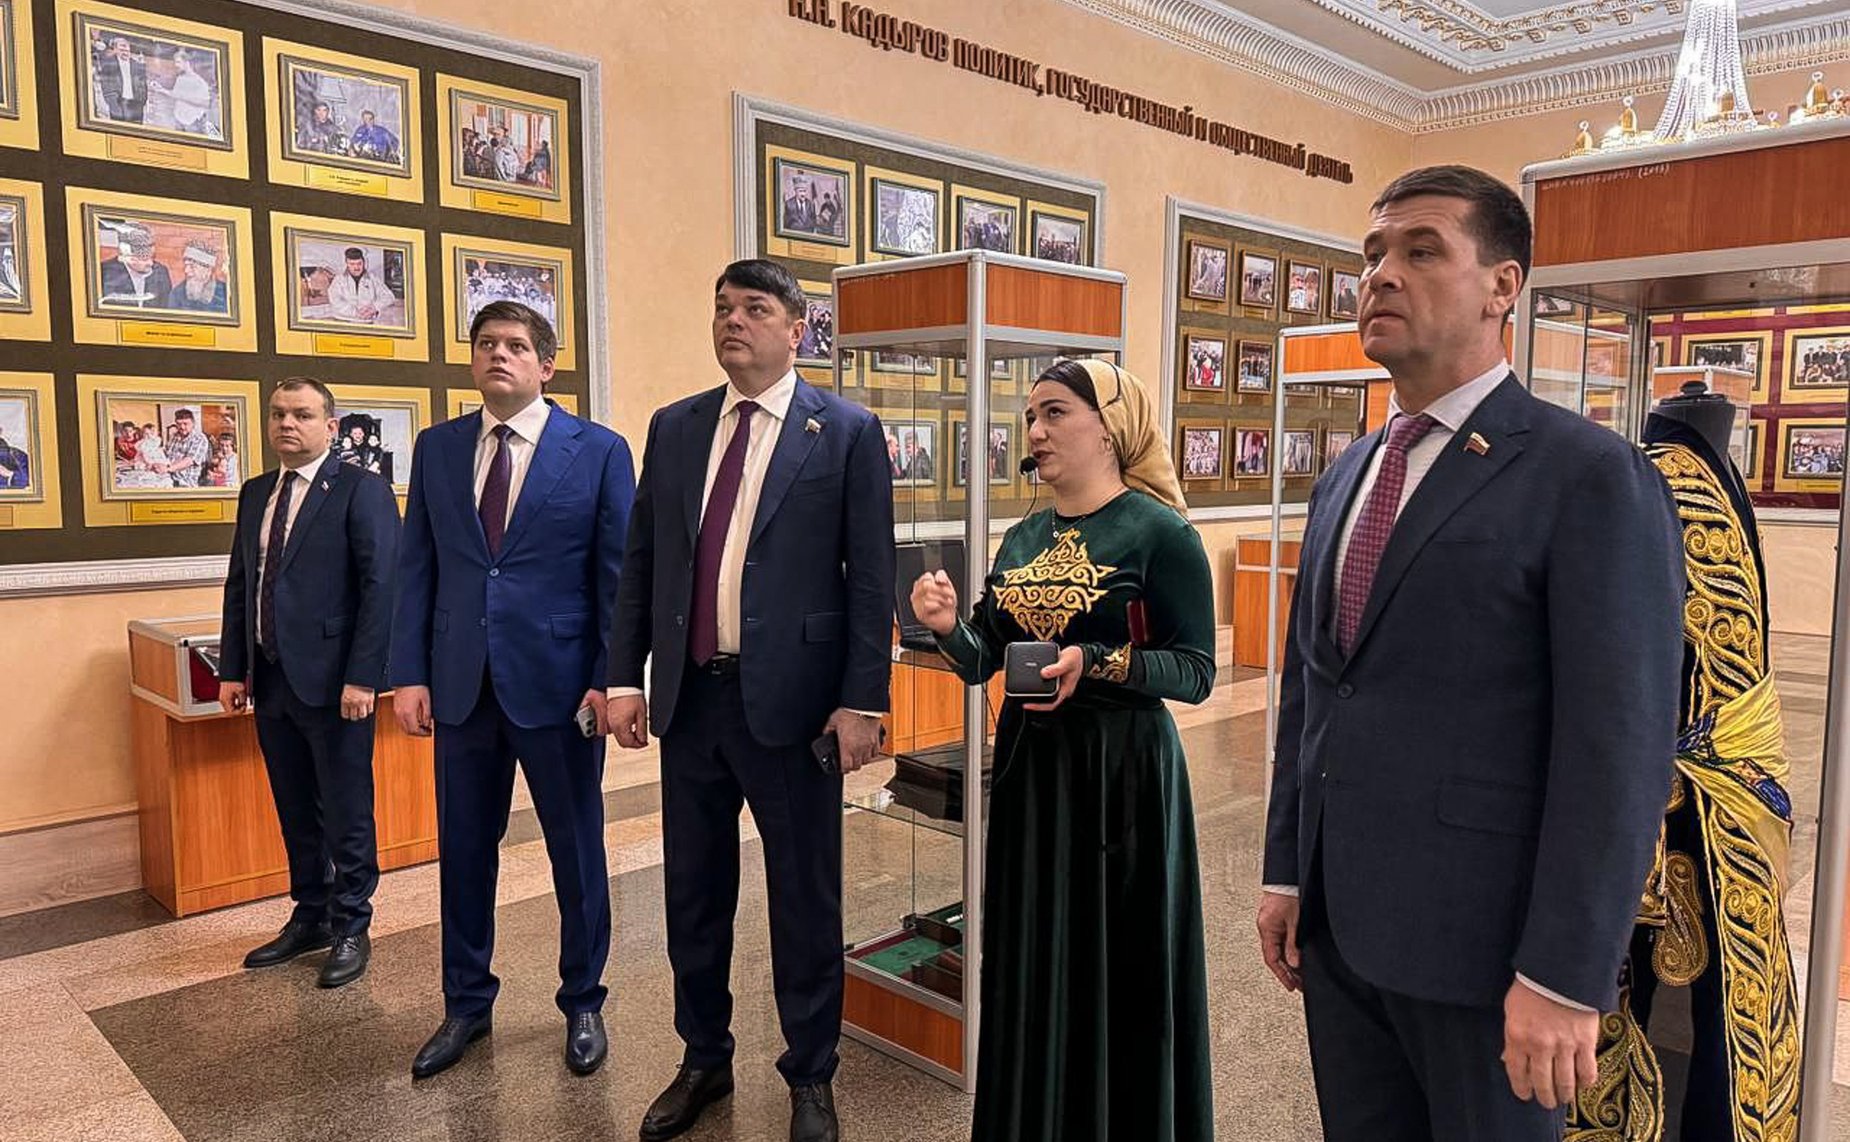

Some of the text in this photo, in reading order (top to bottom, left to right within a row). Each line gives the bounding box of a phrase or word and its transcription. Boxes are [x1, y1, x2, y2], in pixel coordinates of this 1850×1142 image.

[841, 1, 949, 62] КАДЫРОВ
[953, 38, 1044, 97] ПОЛИТИК,
[1046, 68, 1194, 137] ГОСУДАРСТВЕННЫЙ
[1195, 116, 1207, 141] И
[1209, 122, 1306, 170] ОБЩЕСТВЕННЫЙ
